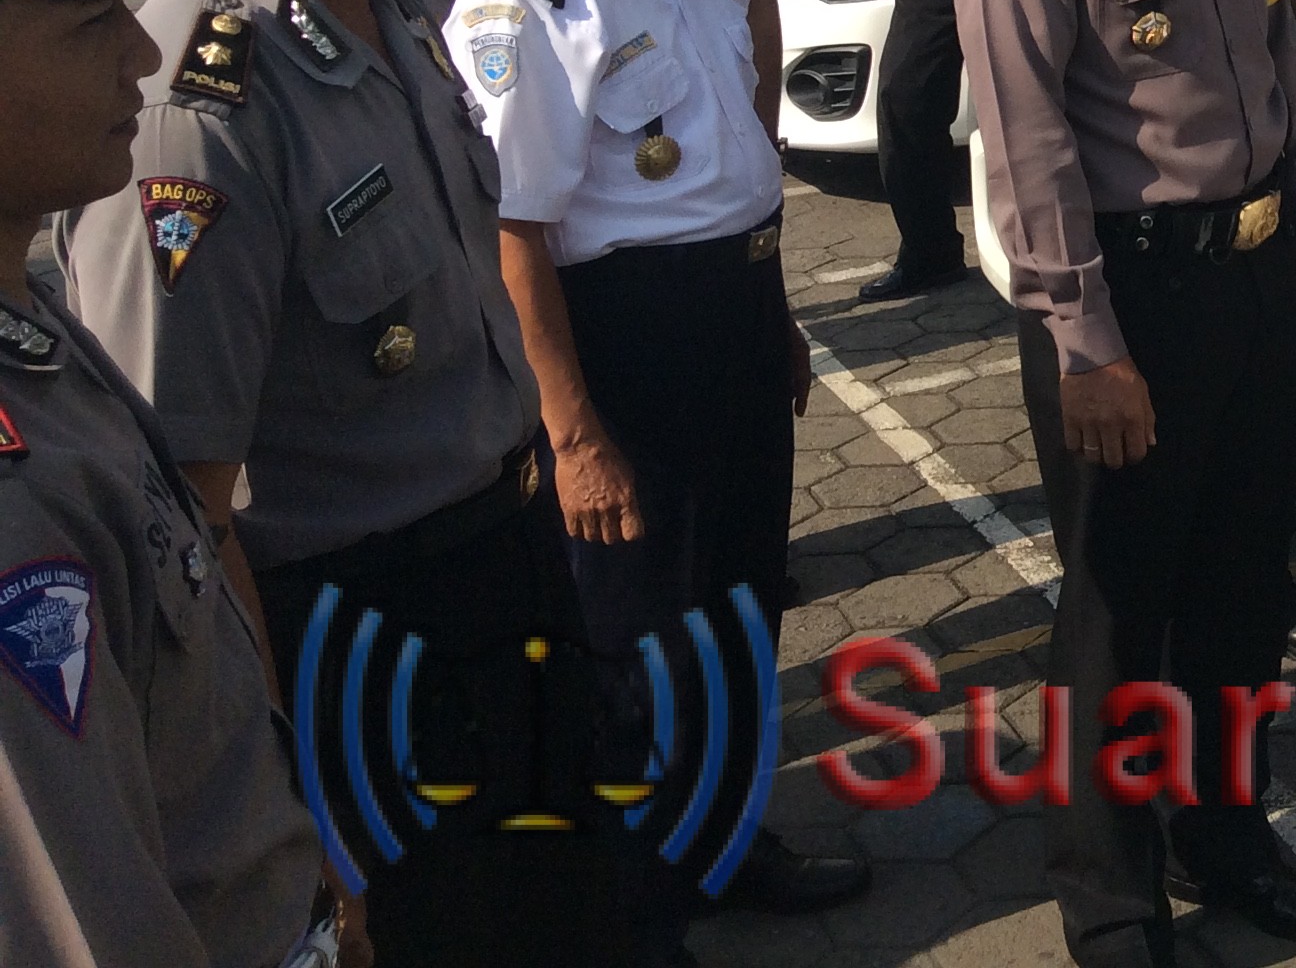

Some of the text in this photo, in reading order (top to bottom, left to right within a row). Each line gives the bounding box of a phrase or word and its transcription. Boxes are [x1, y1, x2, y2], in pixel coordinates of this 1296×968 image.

[182, 70, 242, 94] POLISI
[152, 183, 216, 209] BAG OPS
[23, 571, 52, 590] LALU
[55, 570, 86, 588] LINTAS
